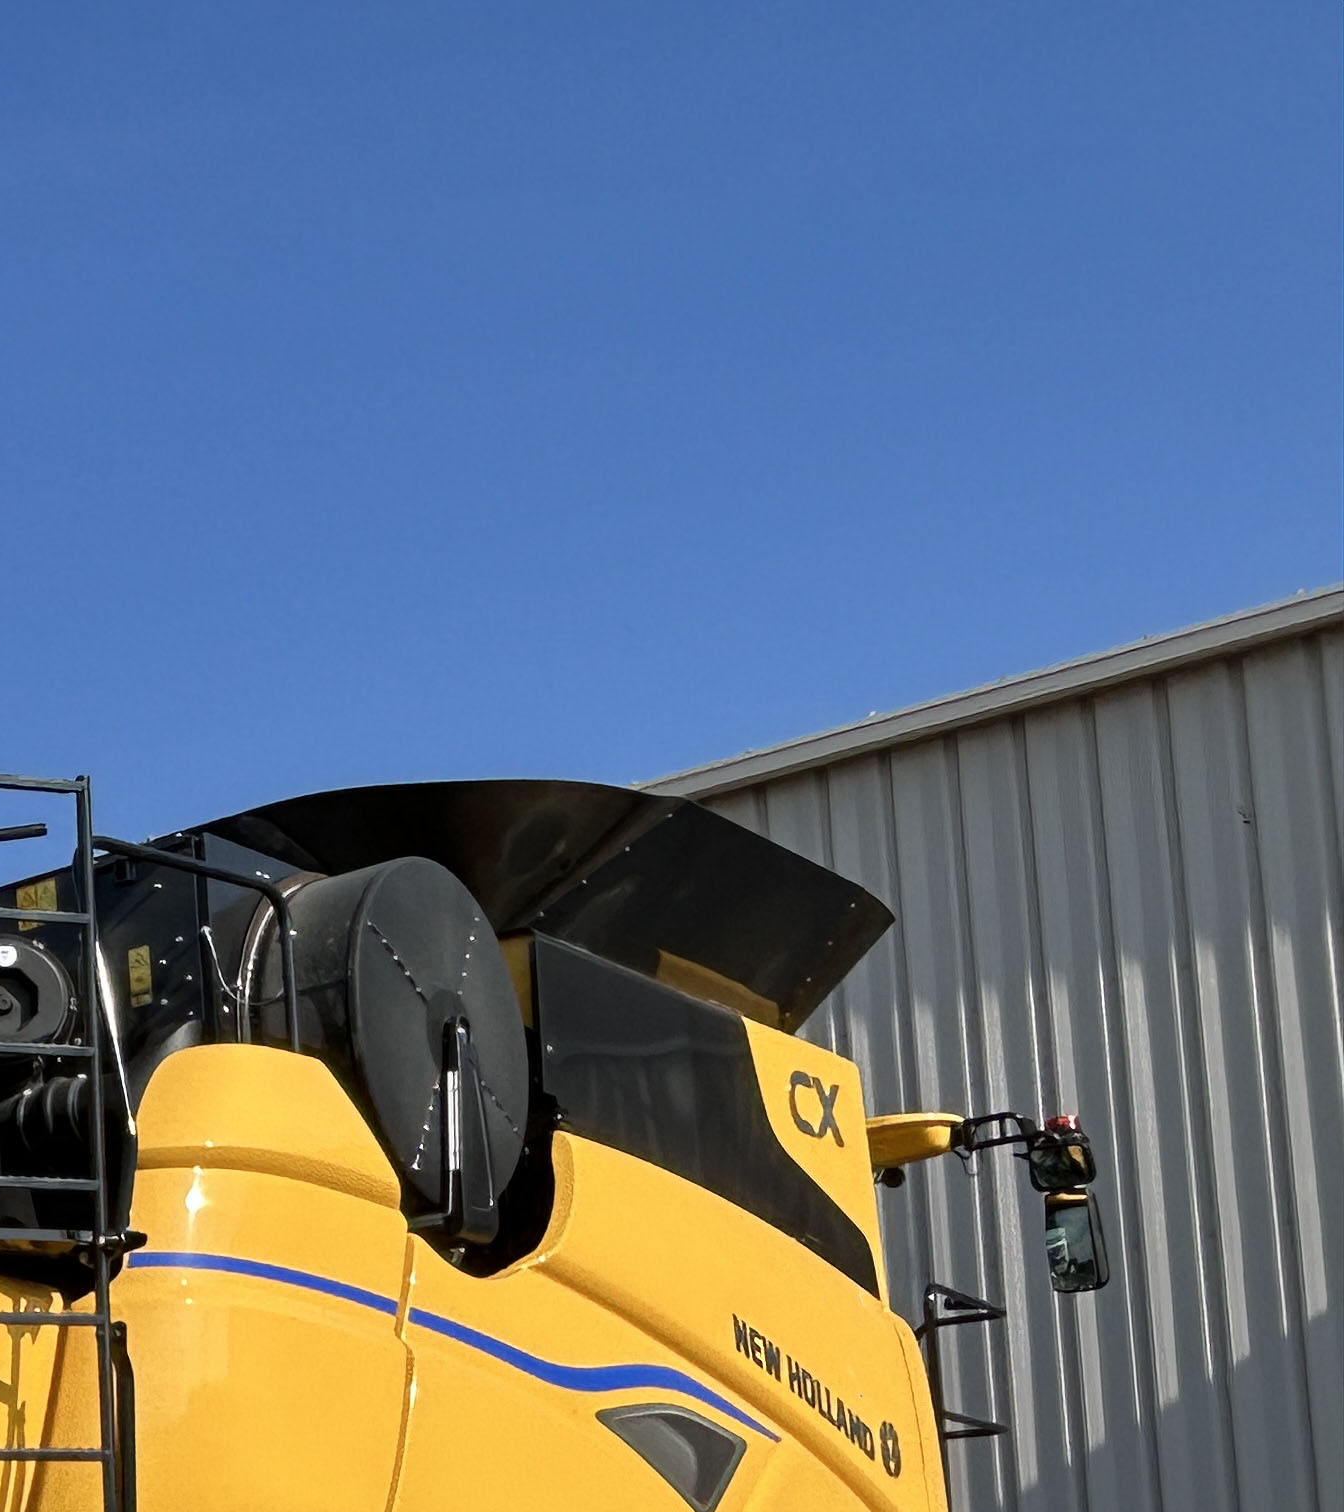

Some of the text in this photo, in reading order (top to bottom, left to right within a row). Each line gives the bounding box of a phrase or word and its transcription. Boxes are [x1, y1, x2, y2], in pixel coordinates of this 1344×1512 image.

[788, 1070, 845, 1148] CX
[732, 1313, 875, 1462] NEW HOLLAND
